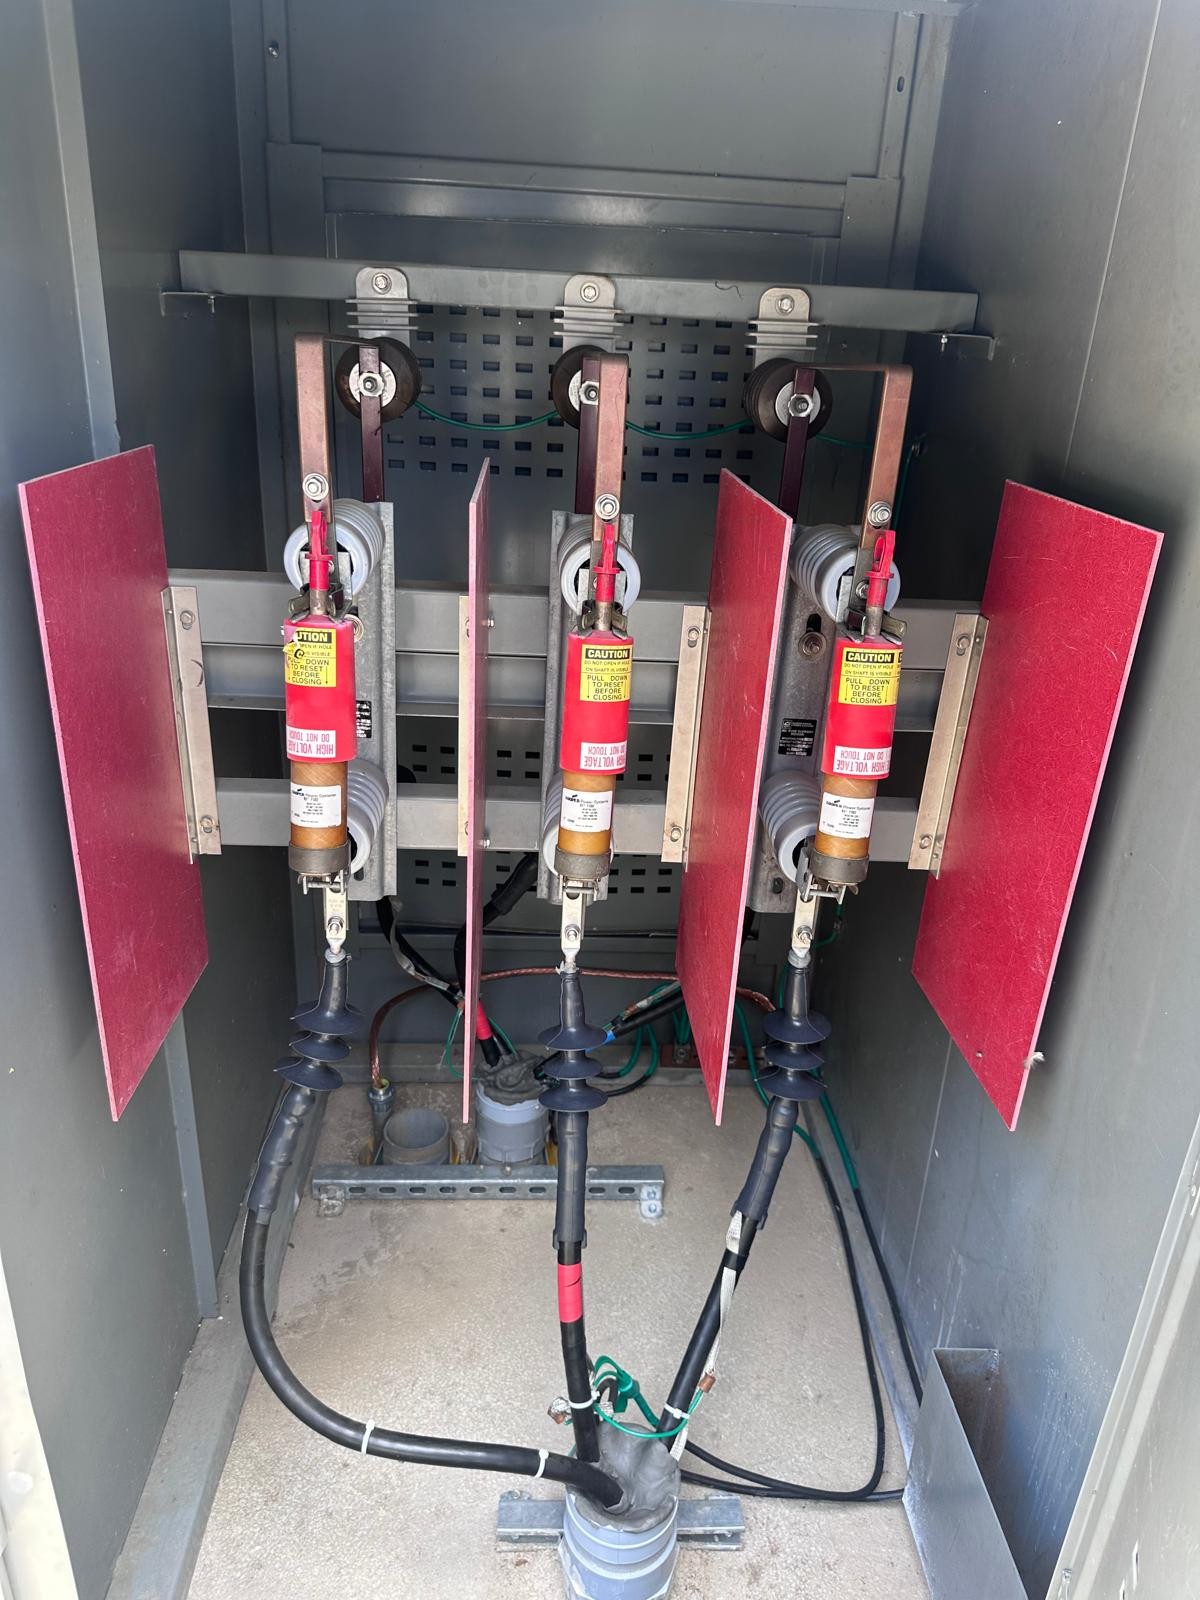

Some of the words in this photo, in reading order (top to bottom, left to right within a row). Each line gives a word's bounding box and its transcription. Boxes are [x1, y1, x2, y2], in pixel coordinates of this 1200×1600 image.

[297, 632, 328, 642] UTION
[587, 650, 628, 659] CAUTION
[847, 652, 892, 662] CAUTION
[293, 670, 321, 679] BEFORE
[292, 677, 322, 685] CLOSING
[846, 677, 863, 685] PULL
[852, 690, 881, 698] BEFORE
[306, 732, 318, 742] NOT
[321, 733, 330, 742] DO
[315, 744, 334, 755] HIGH
[588, 745, 607, 755] TOUCH
[610, 745, 620, 755] NOT
[840, 750, 860, 760] TOUCH
[863, 751, 876, 761] NOT
[877, 751, 884, 761] DO
[584, 755, 614, 768] VOLTAGE
[836, 760, 868, 773] VOLTAGE
